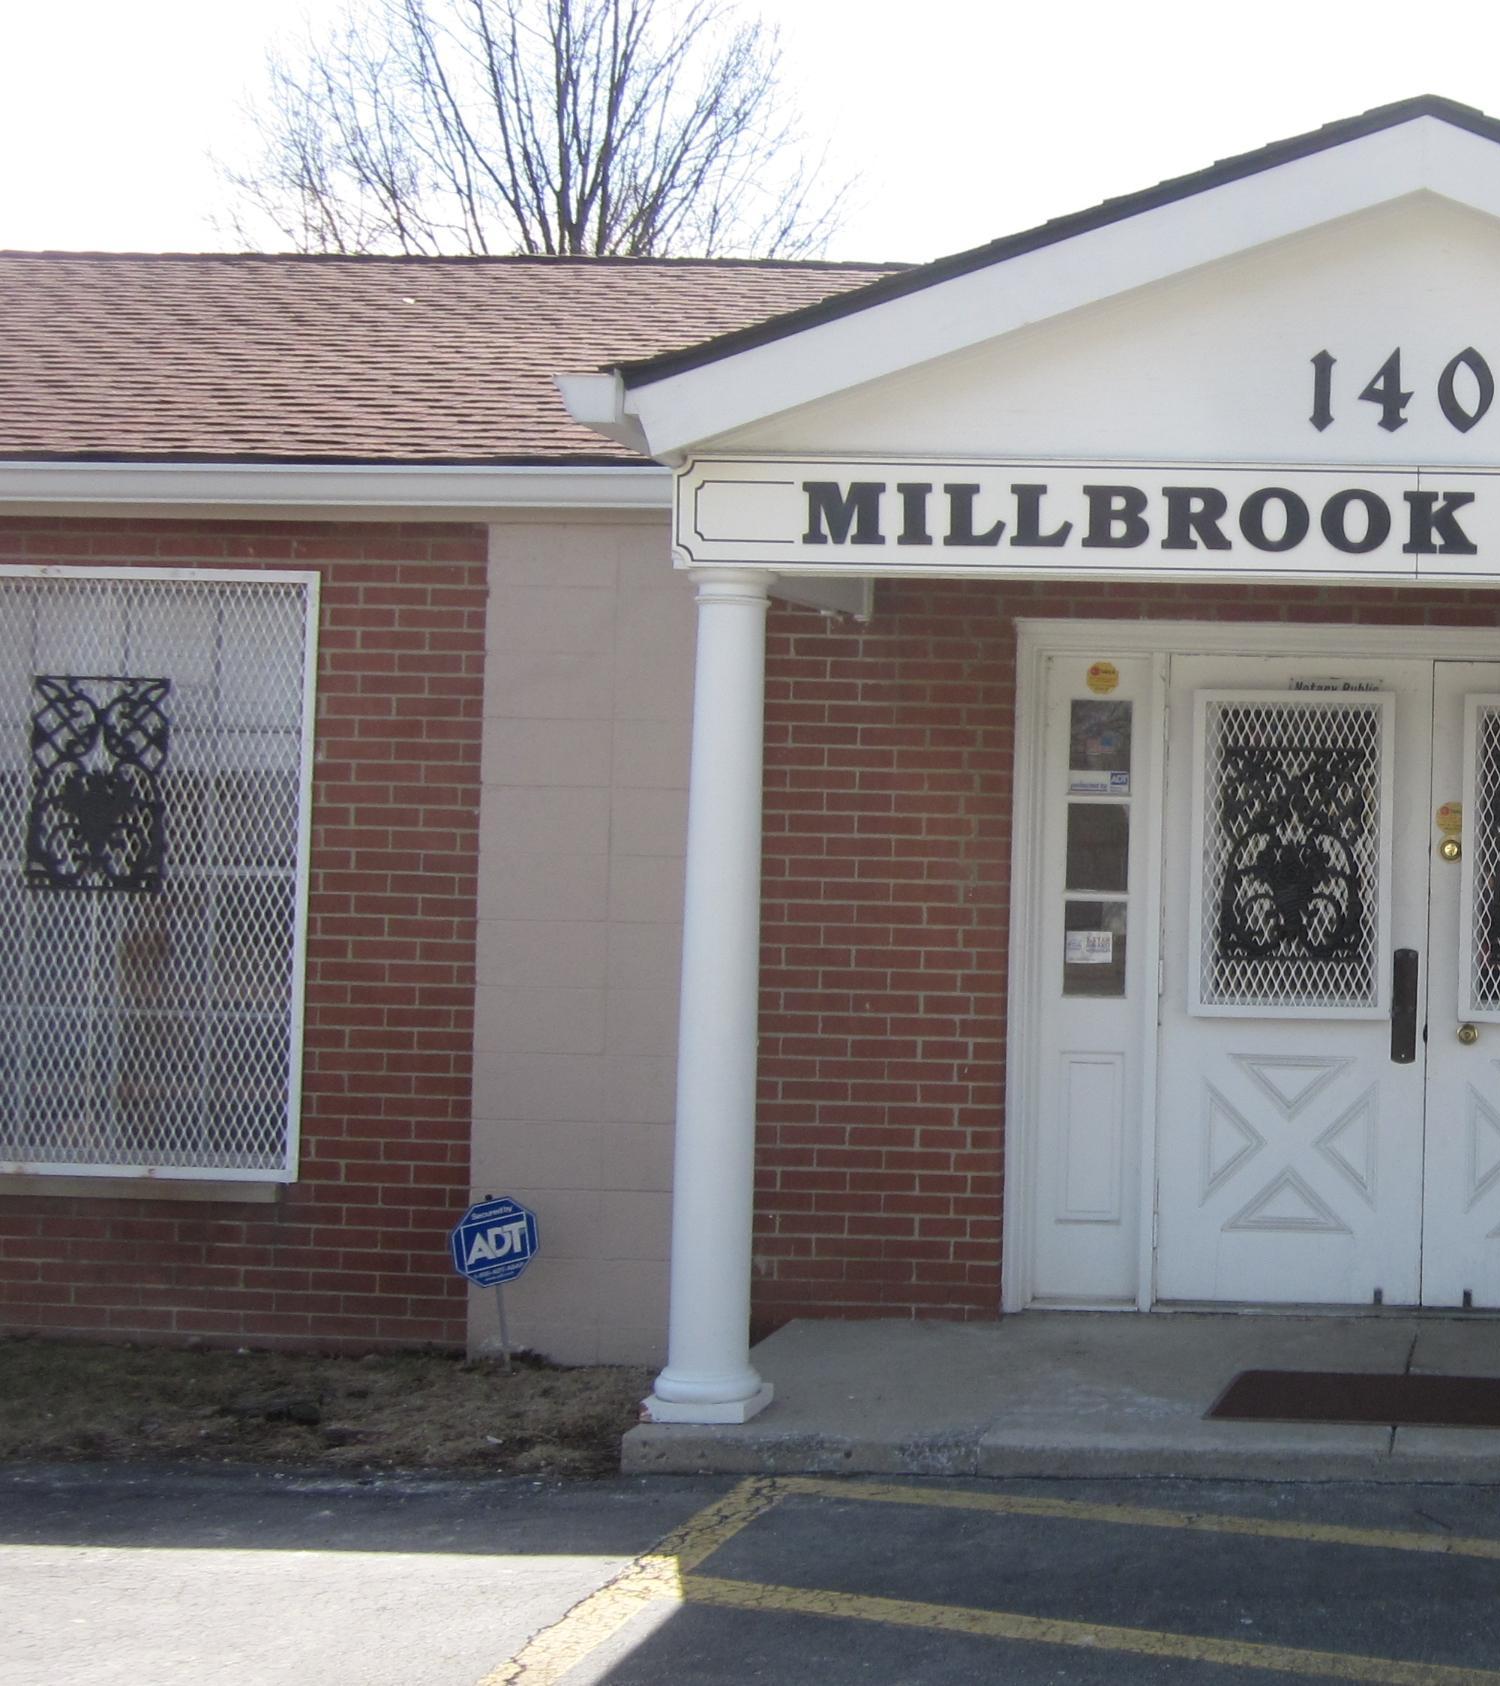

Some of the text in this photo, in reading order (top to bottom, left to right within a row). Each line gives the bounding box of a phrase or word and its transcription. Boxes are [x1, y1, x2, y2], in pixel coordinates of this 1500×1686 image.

[802, 481, 1478, 555] MILLBROOK
[472, 1208, 502, 1220] Secured
[467, 1220, 527, 1266] ADT
